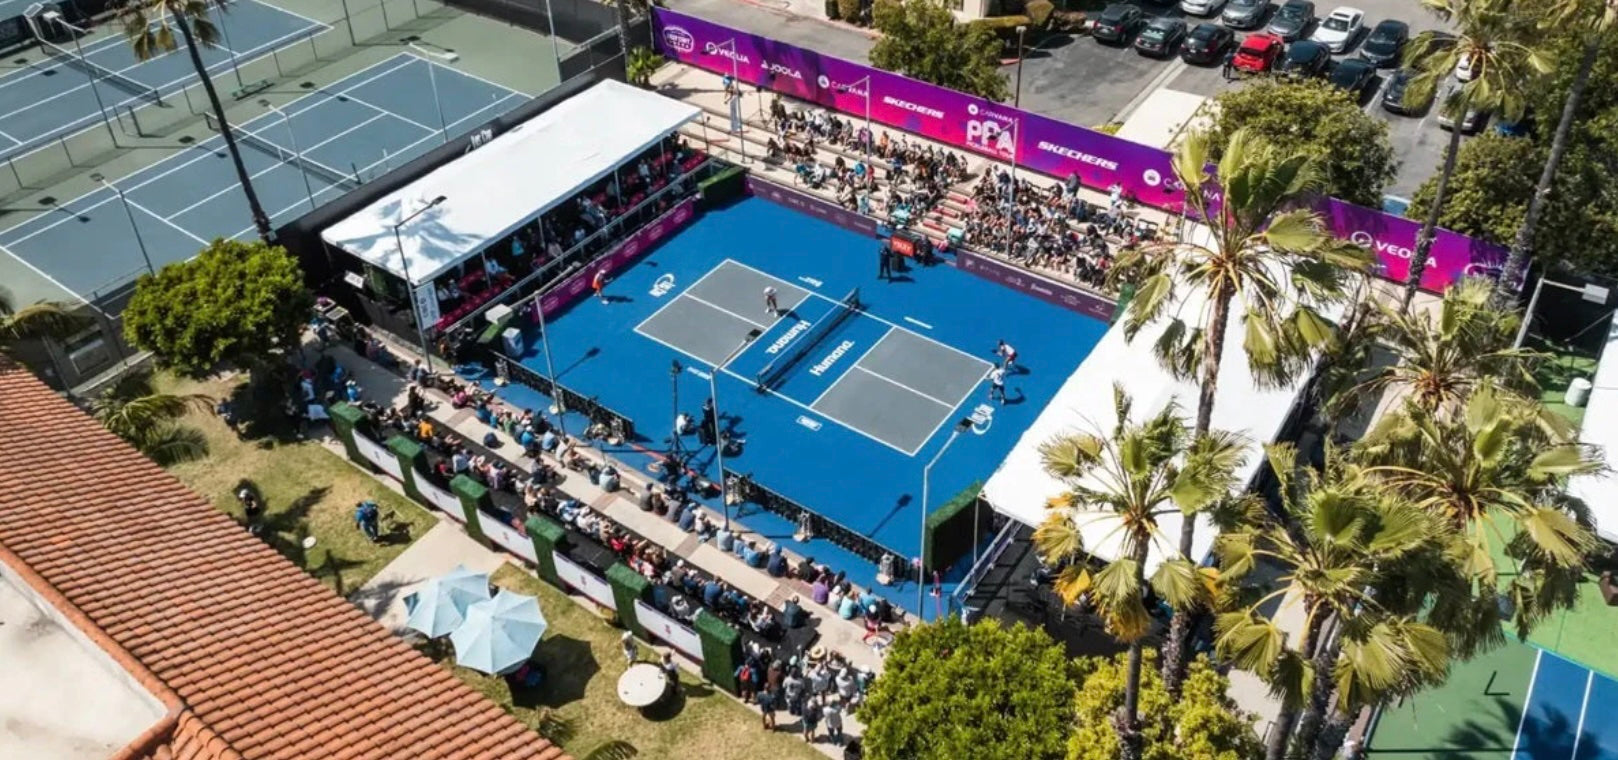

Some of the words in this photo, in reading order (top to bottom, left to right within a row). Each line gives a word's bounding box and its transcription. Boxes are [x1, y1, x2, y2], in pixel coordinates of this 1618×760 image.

[770, 64, 802, 79] JOOLA
[883, 96, 945, 119] SKECHERS
[966, 119, 1014, 154] PPA
[1037, 141, 1119, 171] SKECHERS
[1375, 240, 1437, 269] VEOA
